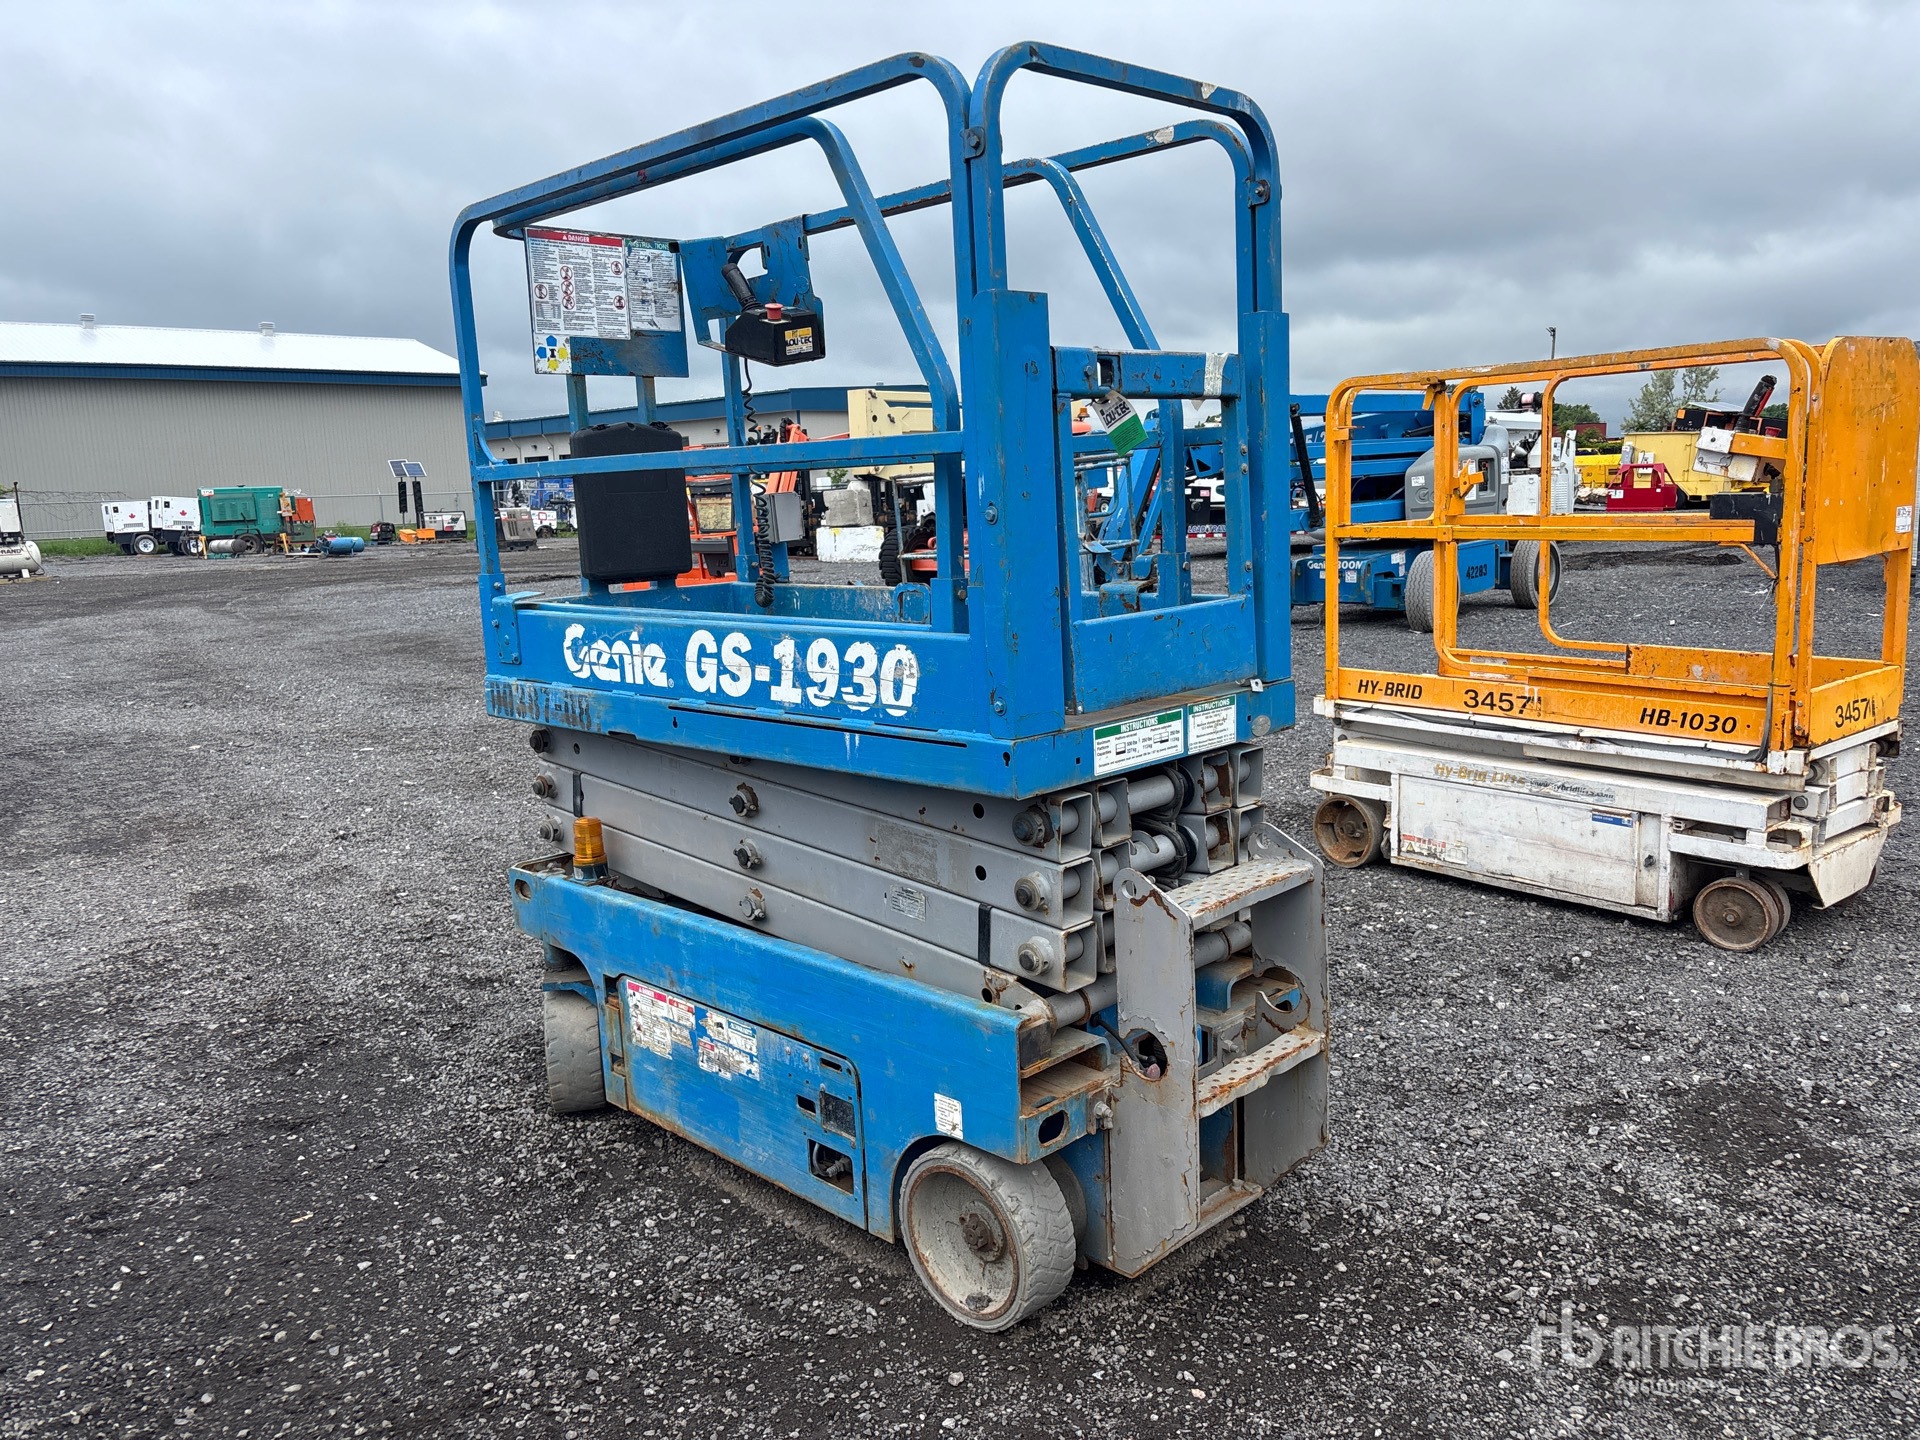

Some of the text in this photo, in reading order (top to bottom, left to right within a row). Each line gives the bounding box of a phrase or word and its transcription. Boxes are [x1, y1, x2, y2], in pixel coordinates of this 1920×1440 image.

[568, 234, 590, 243] DANGER
[1307, 560, 1326, 570] Geni
[1465, 563, 1488, 580] 42283
[563, 623, 670, 688] Genie
[685, 629, 920, 717] GS-1930
[1357, 679, 1423, 700] HY-BRID
[1193, 698, 1230, 712] INSTRUCTIONS
[1120, 717, 1158, 733] INSTRUCTIONS
[1639, 707, 1738, 734] HB-1030
